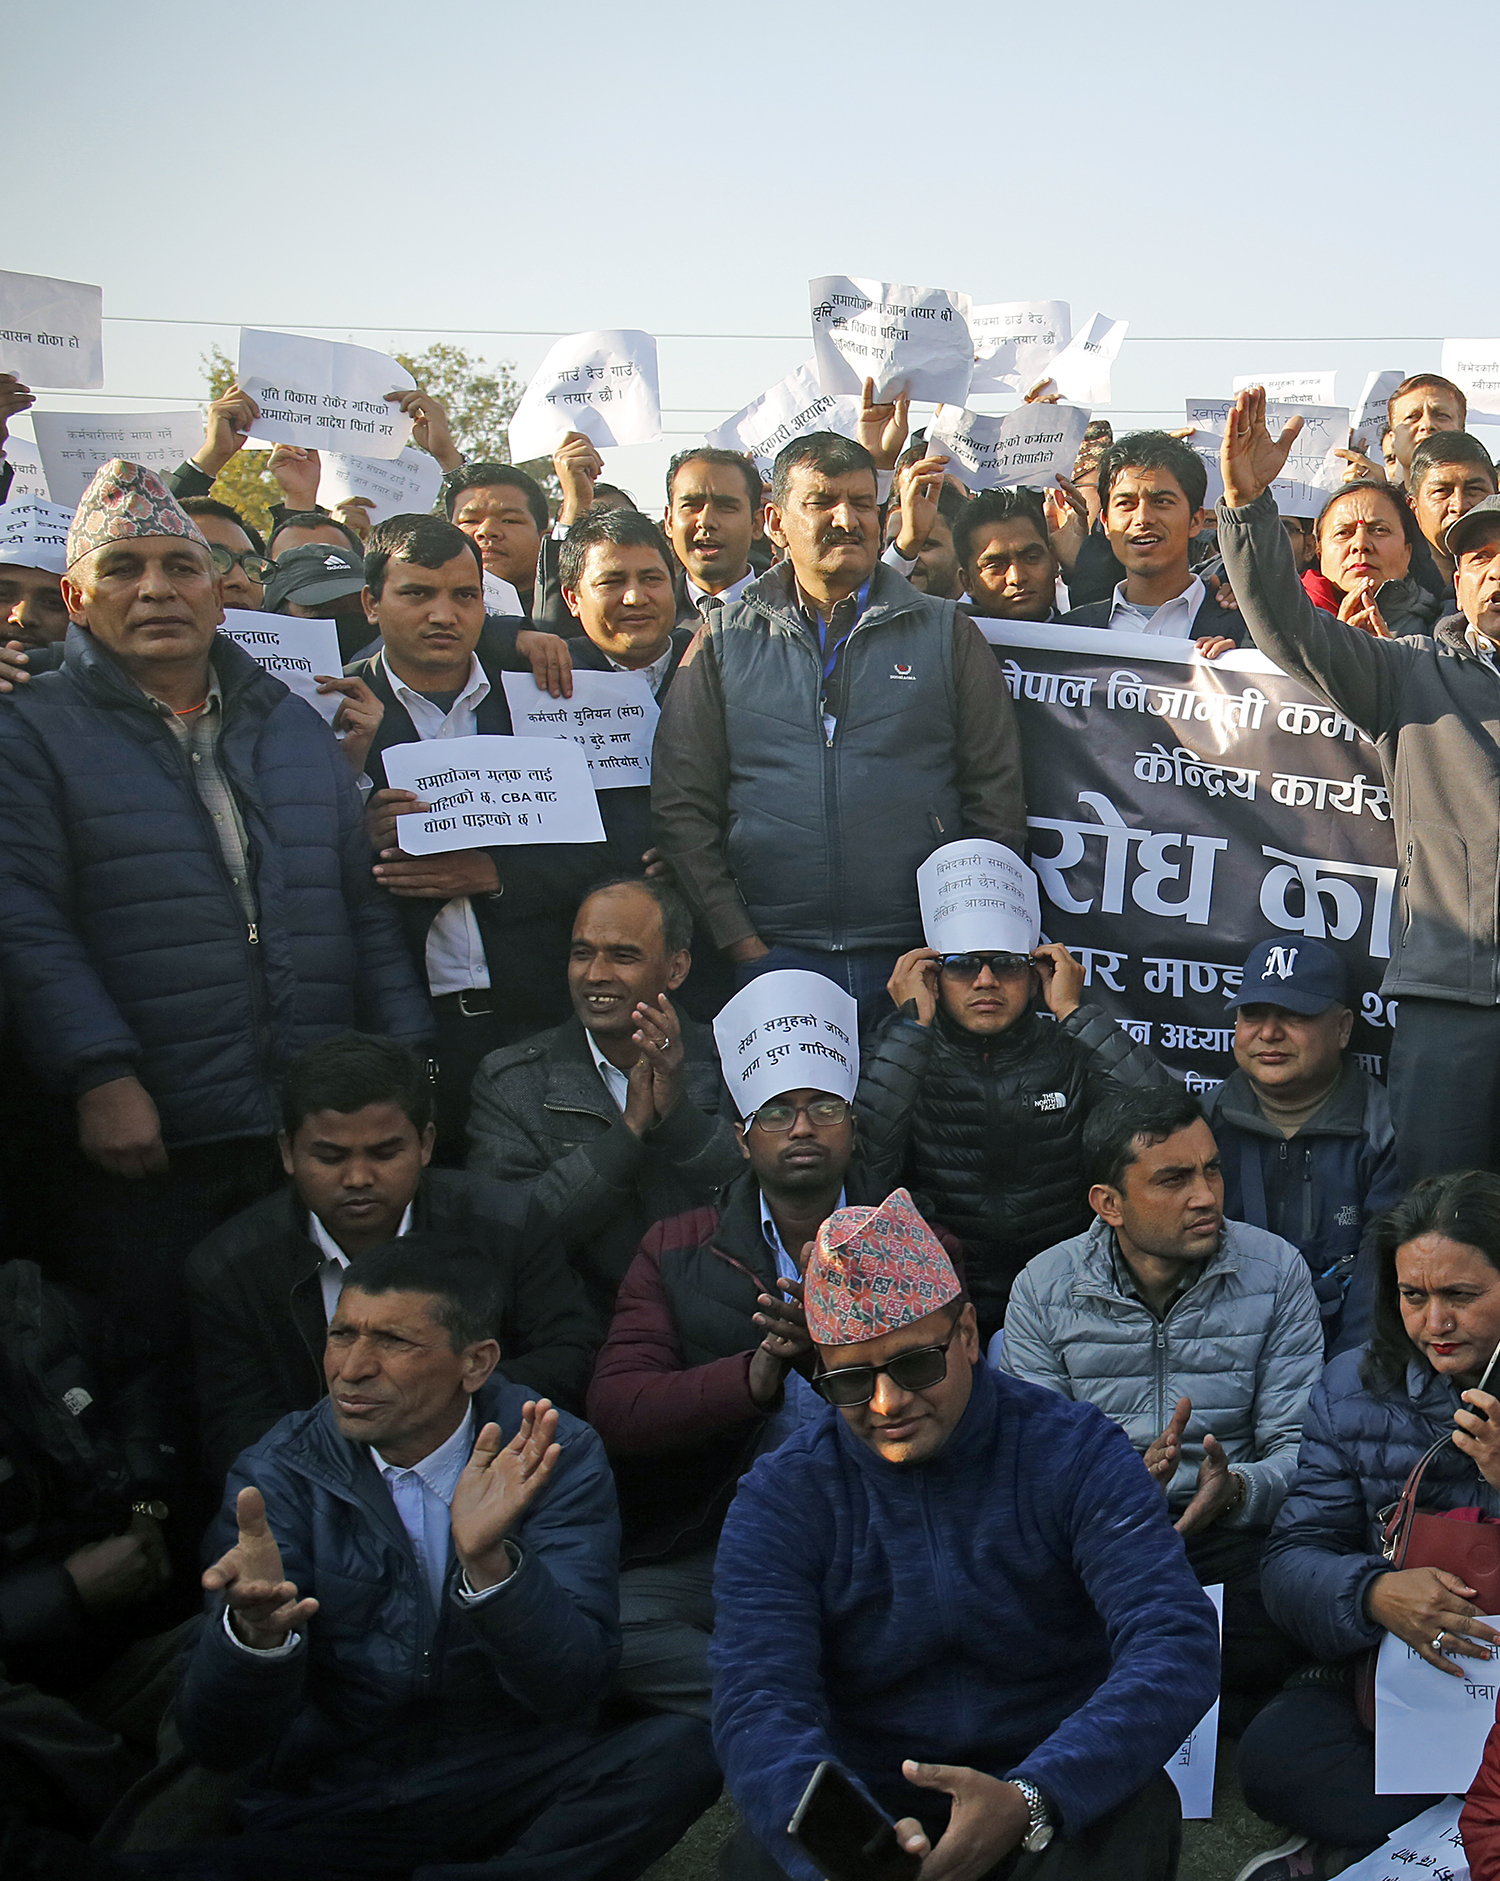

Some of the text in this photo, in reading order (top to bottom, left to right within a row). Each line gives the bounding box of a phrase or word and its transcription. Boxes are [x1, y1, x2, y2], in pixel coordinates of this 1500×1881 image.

[886, 303, 907, 318] जान
[911, 306, 937, 320] तयार
[37, 331, 79, 348] धोका हो
[851, 319, 878, 337] विकास
[880, 325, 909, 341] पहिला
[988, 337, 1008, 347] जान
[1012, 335, 1037, 345] तयार
[586, 365, 604, 380] देउ
[1457, 361, 1500, 373] विभेदकारी
[284, 389, 317, 406] विकास
[322, 394, 349, 410] रोकेर
[352, 401, 389, 416] गरिएको
[563, 392, 593, 405] तयार
[260, 407, 394, 437] समायोजन आदेश फिर्ता गर
[66, 430, 125, 442] कर्मचारीलाई
[130, 431, 152, 440] माया
[168, 447, 185, 459] देउ
[1001, 658, 1269, 731] नेपाल निजामती
[527, 703, 646, 727] कर्मचारी युनियन (संघ)
[610, 732, 632, 744] माग
[415, 767, 482, 792] समायोजन
[526, 766, 554, 783] लाई
[500, 792, 533, 804] CBA
[534, 790, 558, 804] बाट
[1269, 773, 1397, 822] कार्यस
[424, 811, 530, 834] धोका पाइएको छ
[936, 853, 1024, 883] विभेदकारी समायोजन
[1025, 790, 1228, 926] रोध
[937, 874, 973, 897] स्वीकार्य
[1261, 944, 1299, 981] N
[737, 1028, 759, 1056] लेखा
[762, 1013, 818, 1033] समुहको
[740, 1055, 761, 1082] माग
[765, 1043, 791, 1067] पुरा
